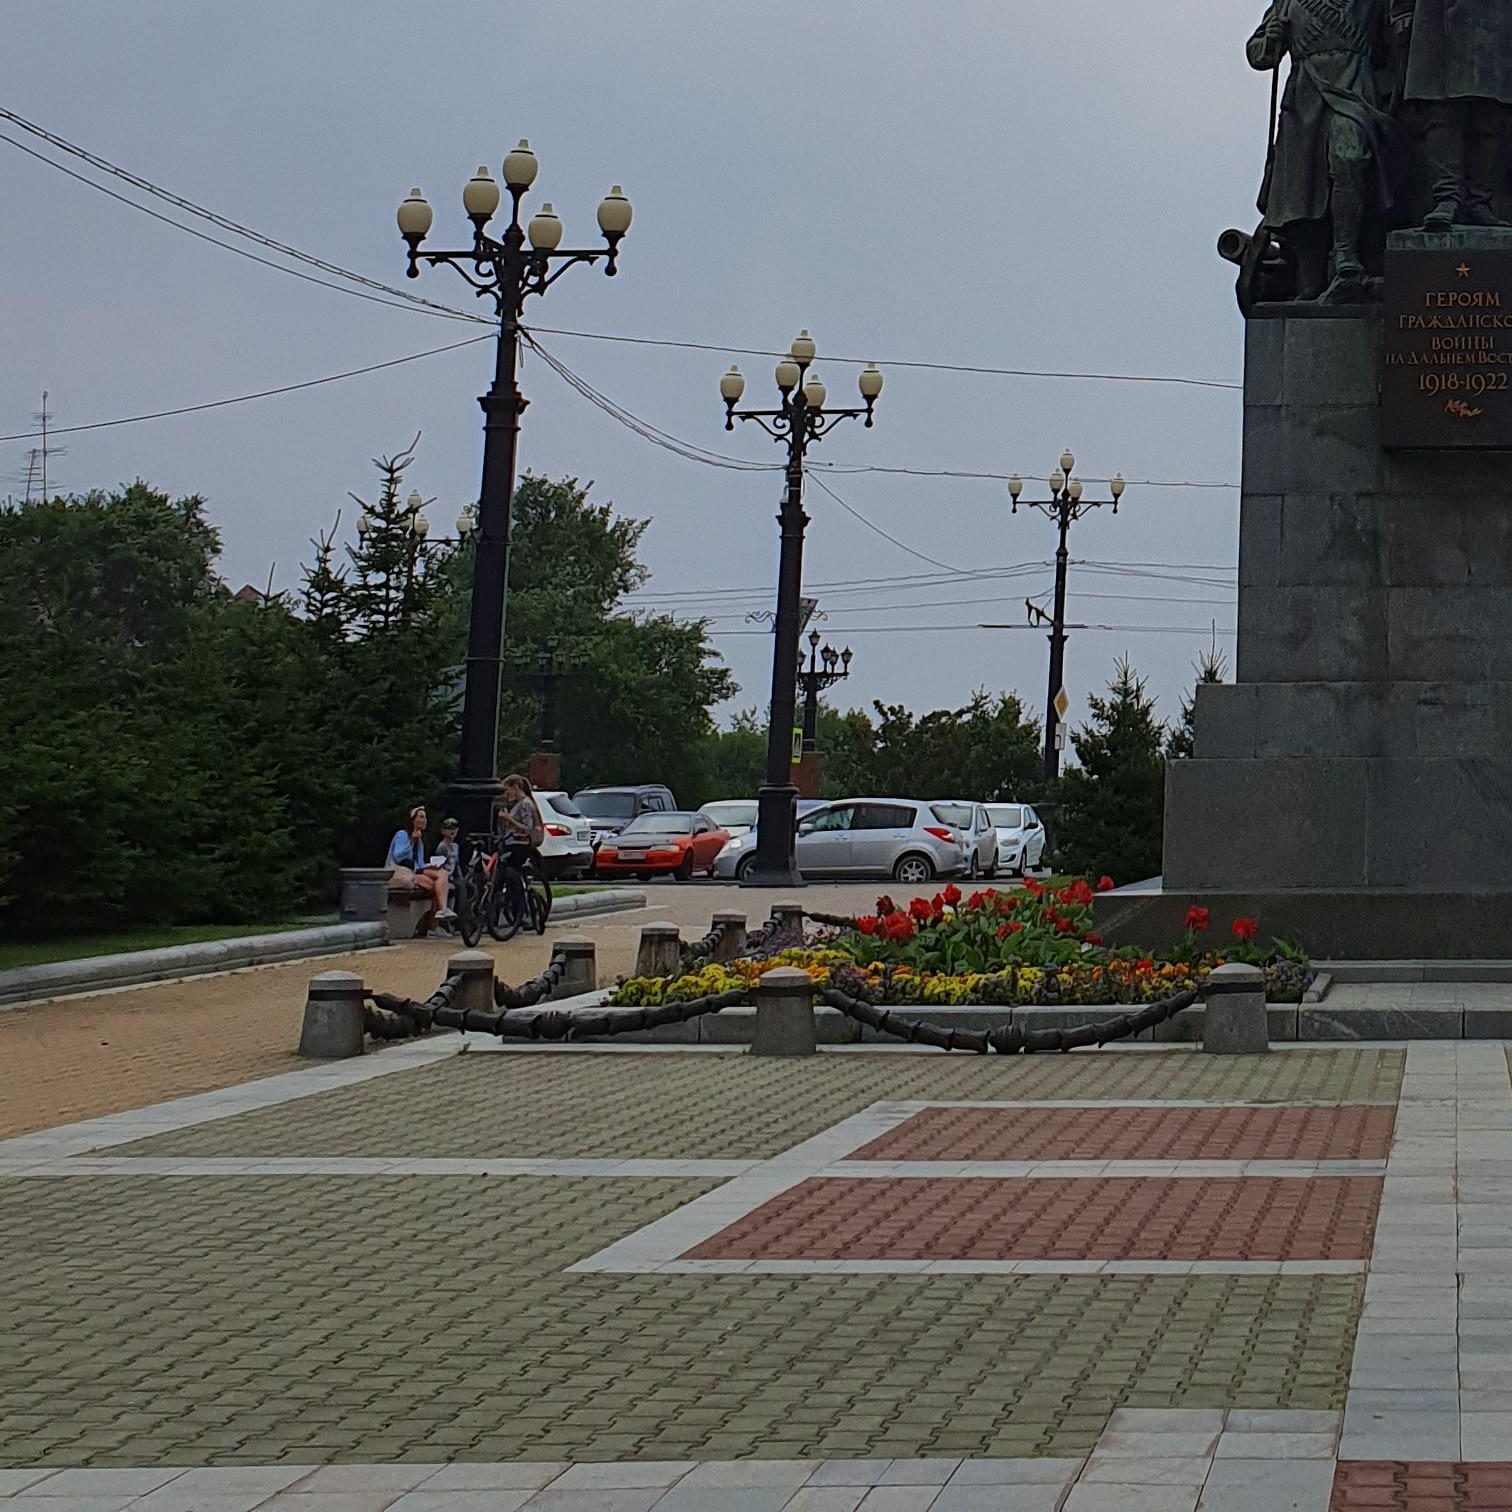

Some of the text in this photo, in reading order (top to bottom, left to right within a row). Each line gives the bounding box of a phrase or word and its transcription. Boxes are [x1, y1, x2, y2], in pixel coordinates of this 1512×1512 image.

[1425, 292, 1500, 306] ГЕРОЯМ
[1432, 335, 1494, 349] ВОЙНЫ
[1420, 373, 1508, 396] 1918-1922
